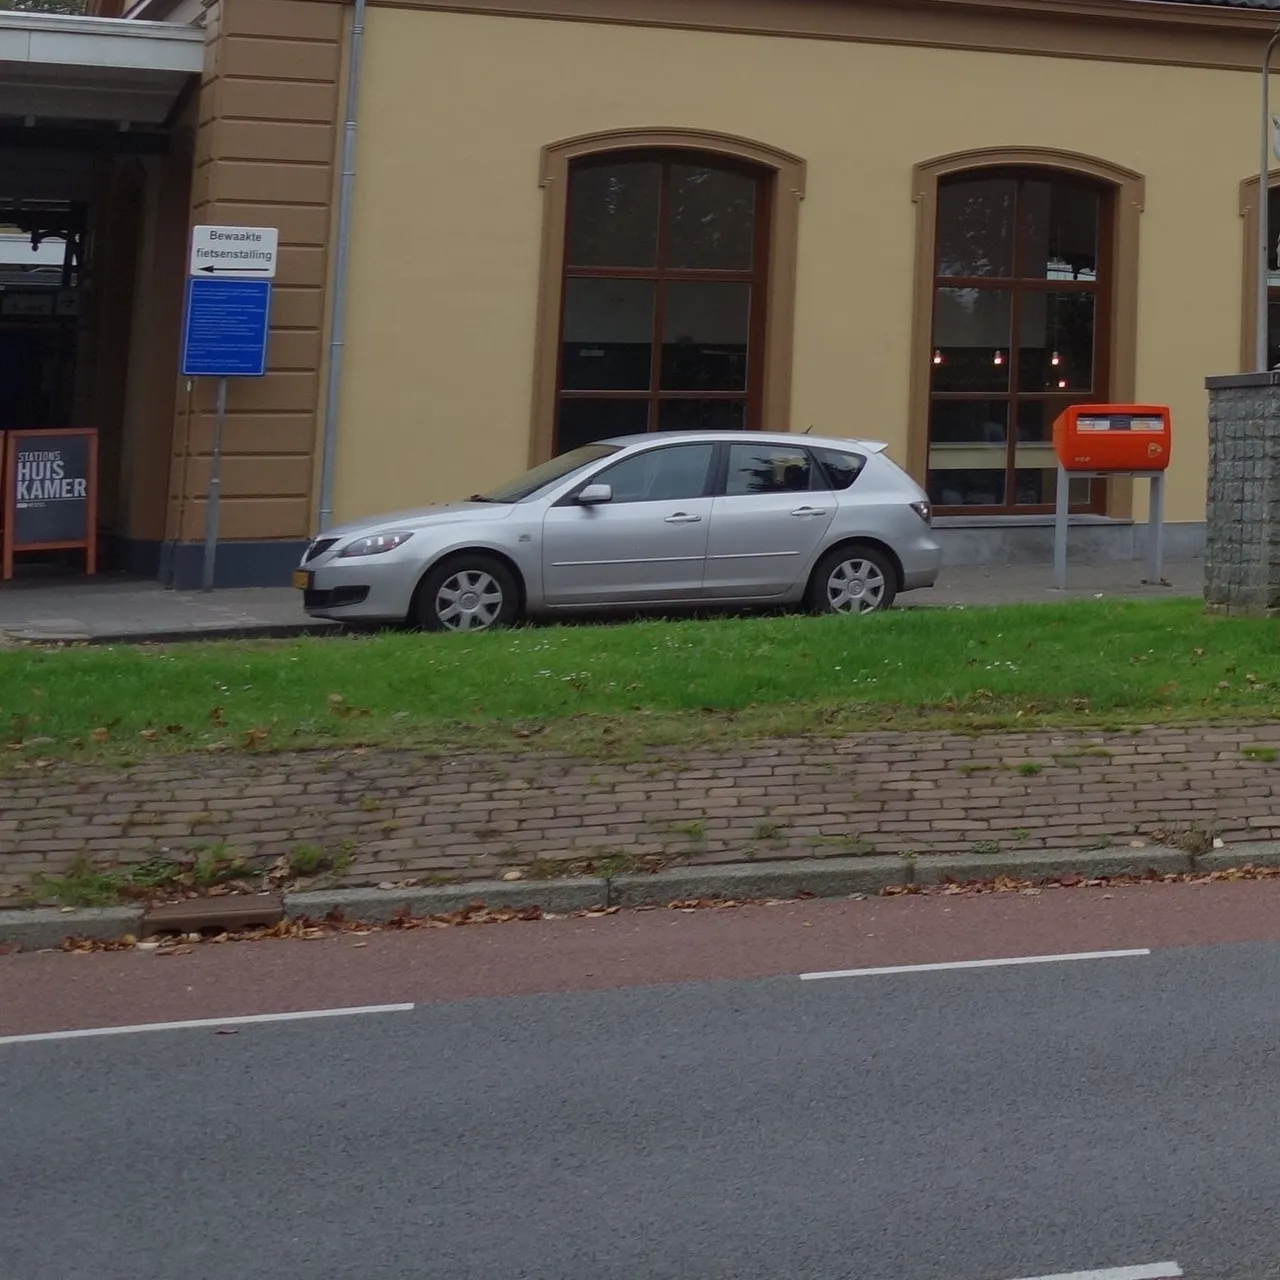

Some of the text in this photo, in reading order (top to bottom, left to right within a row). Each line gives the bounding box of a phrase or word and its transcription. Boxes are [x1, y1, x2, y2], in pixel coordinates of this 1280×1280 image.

[209, 230, 262, 242] Bewaakte
[196, 248, 272, 261] fietsenstalling
[18, 451, 61, 462] STATIONS
[17, 460, 65, 480] HUIS
[16, 478, 87, 500] KAMER
